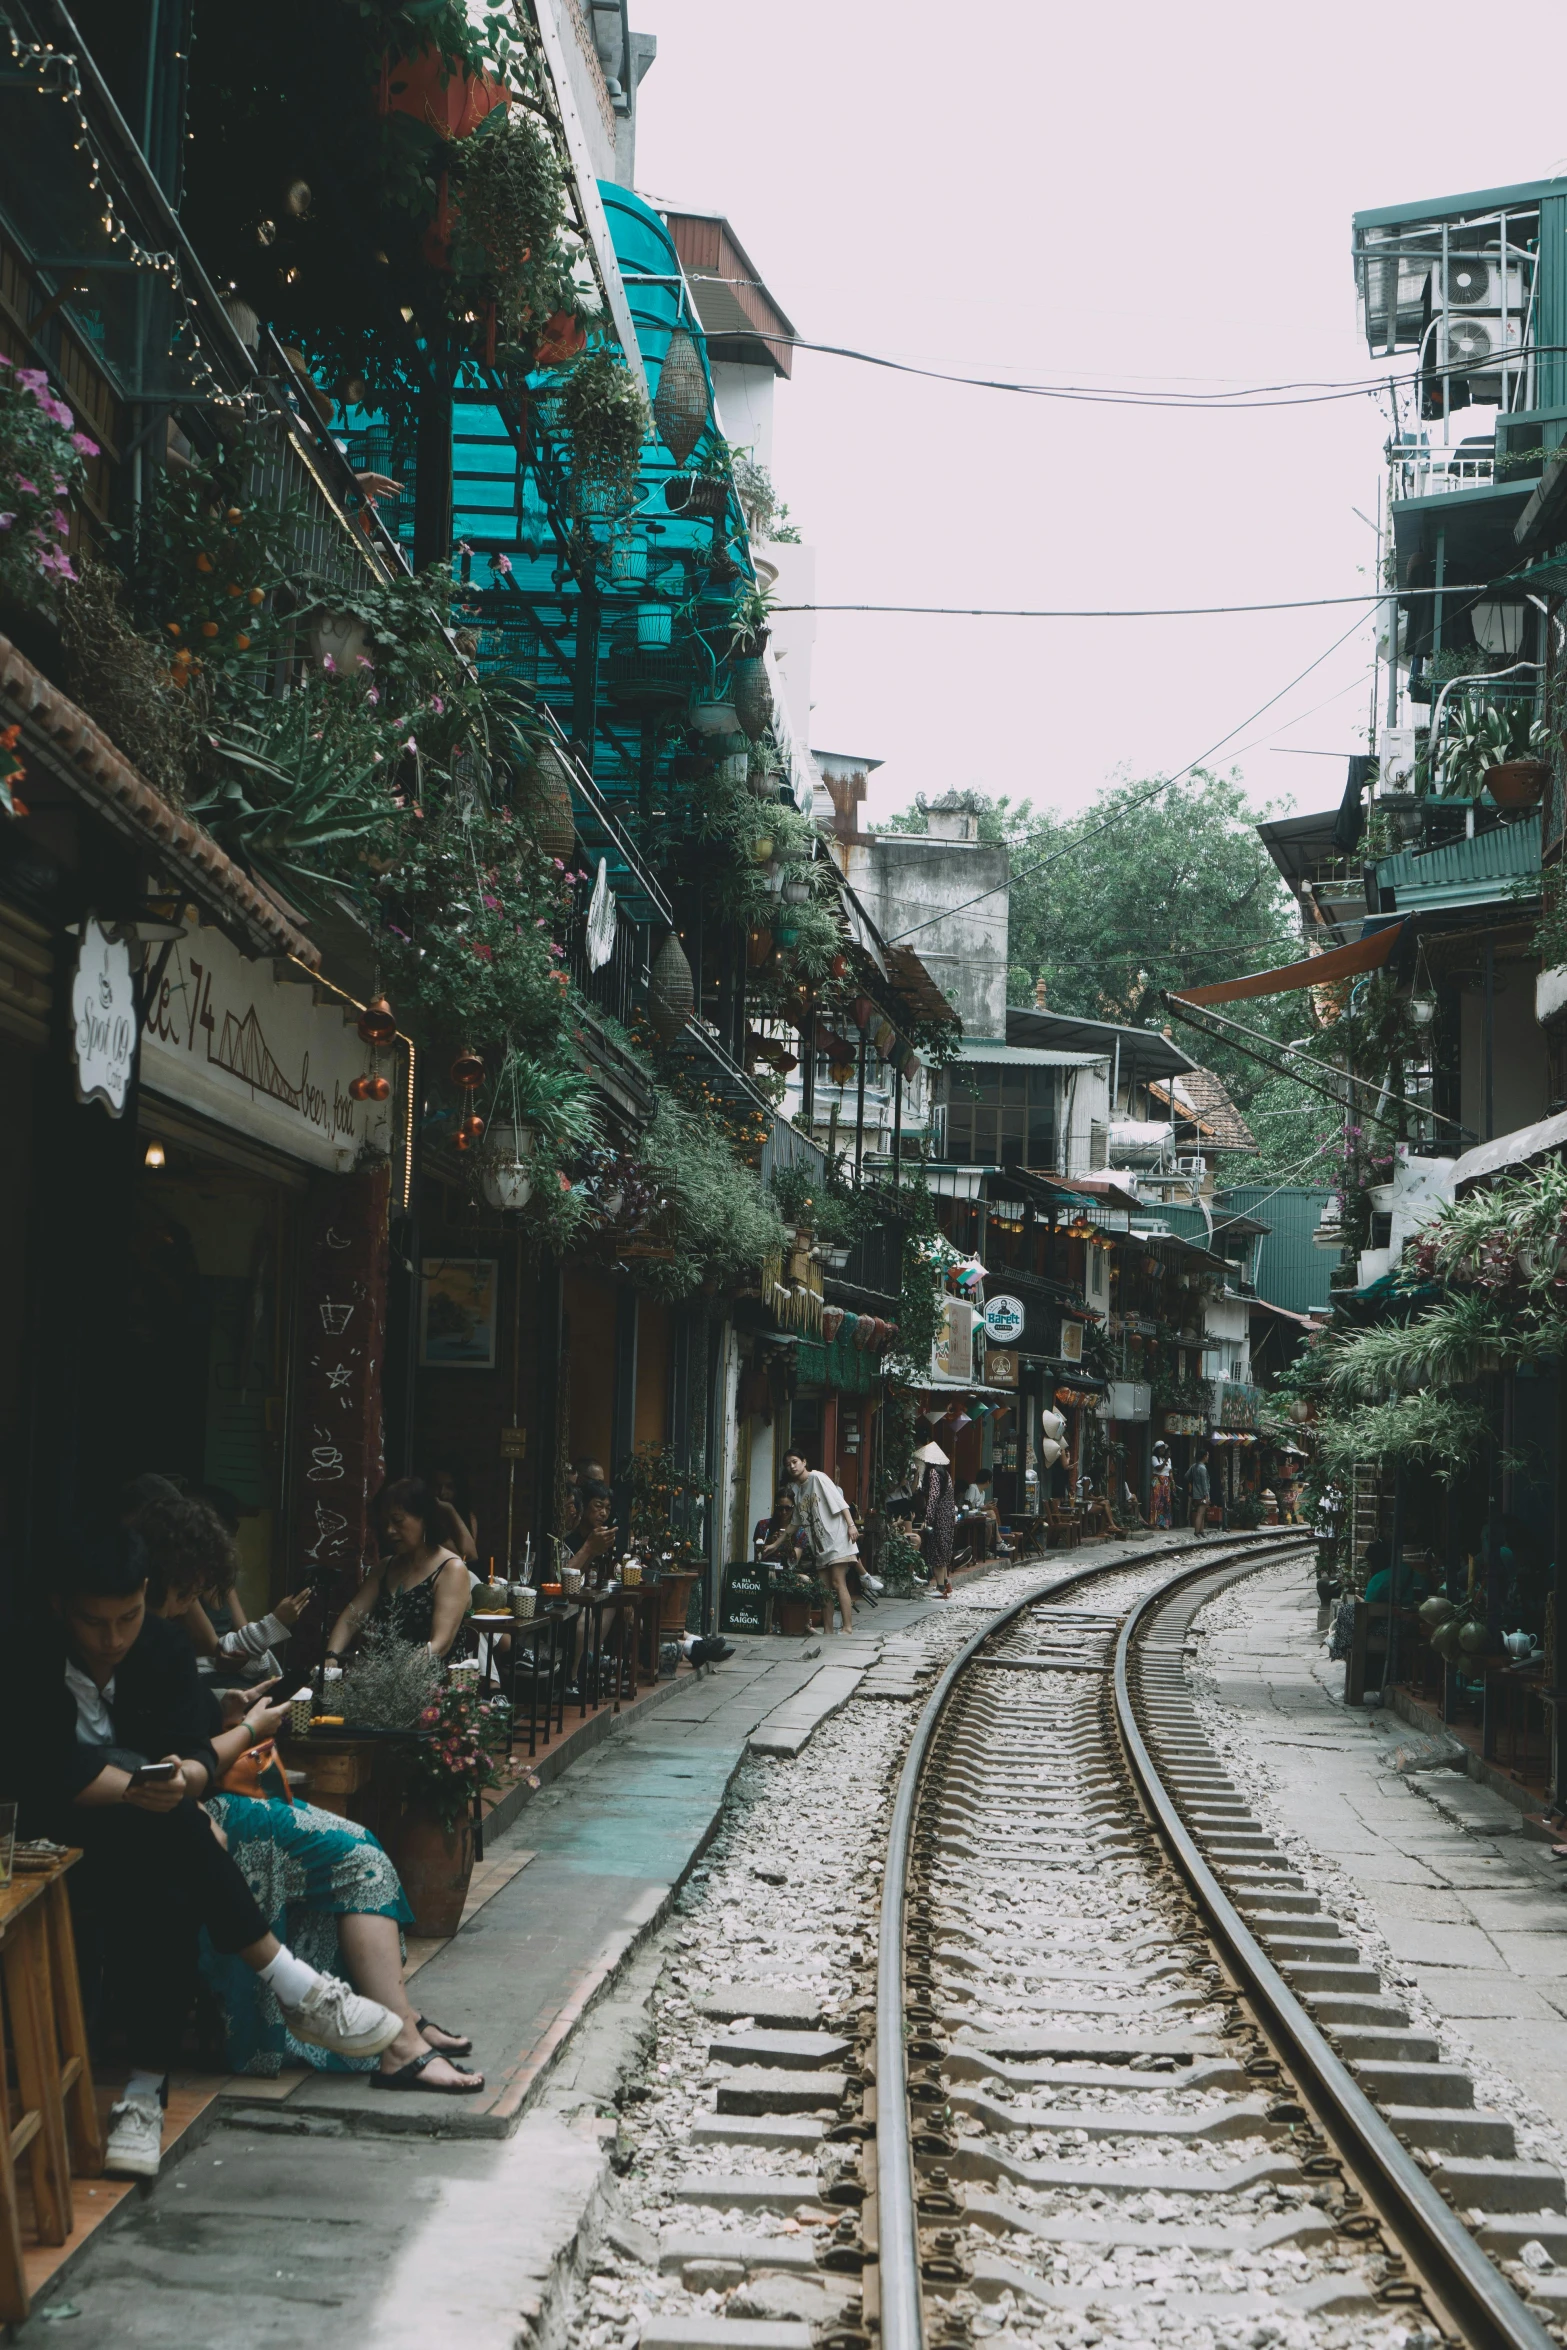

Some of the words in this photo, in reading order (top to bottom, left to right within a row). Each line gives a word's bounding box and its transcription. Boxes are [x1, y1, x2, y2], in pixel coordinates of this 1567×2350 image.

[79, 996, 111, 1061] Spot
[113, 1015, 130, 1065] 09
[330, 1079, 355, 1142] food
[987, 1312, 1020, 1325] Barett
[731, 1581, 760, 1591] SAIGON
[729, 1615, 759, 1625] SAIGON
